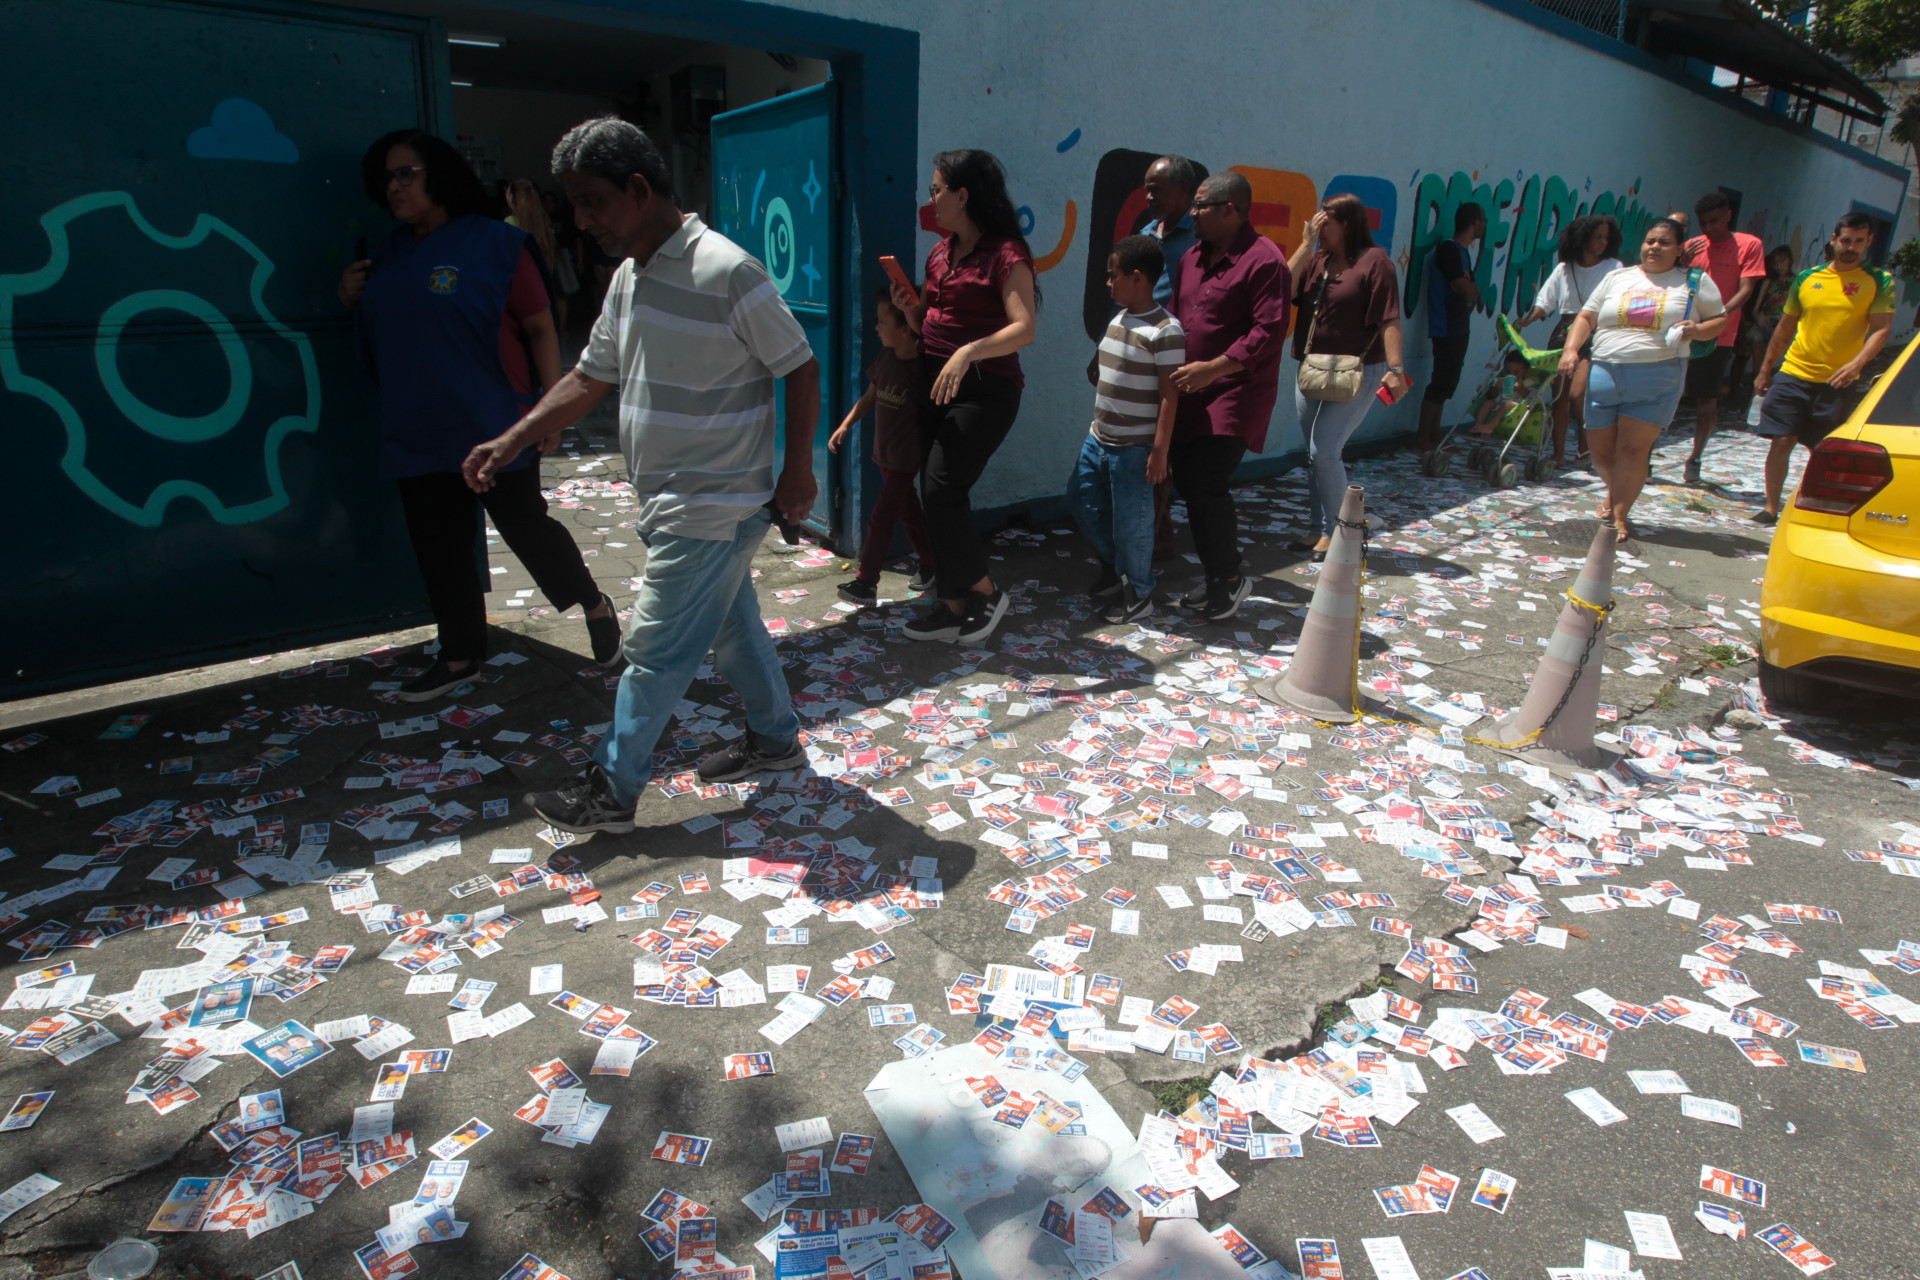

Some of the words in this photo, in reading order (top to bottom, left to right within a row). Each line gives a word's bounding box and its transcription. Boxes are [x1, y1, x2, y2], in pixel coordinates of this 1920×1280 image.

[1865, 511, 1909, 524] POLO
[682, 1139, 693, 1152] 1515
[304, 1150, 325, 1160] 1515
[367, 1255, 388, 1267] 1515
